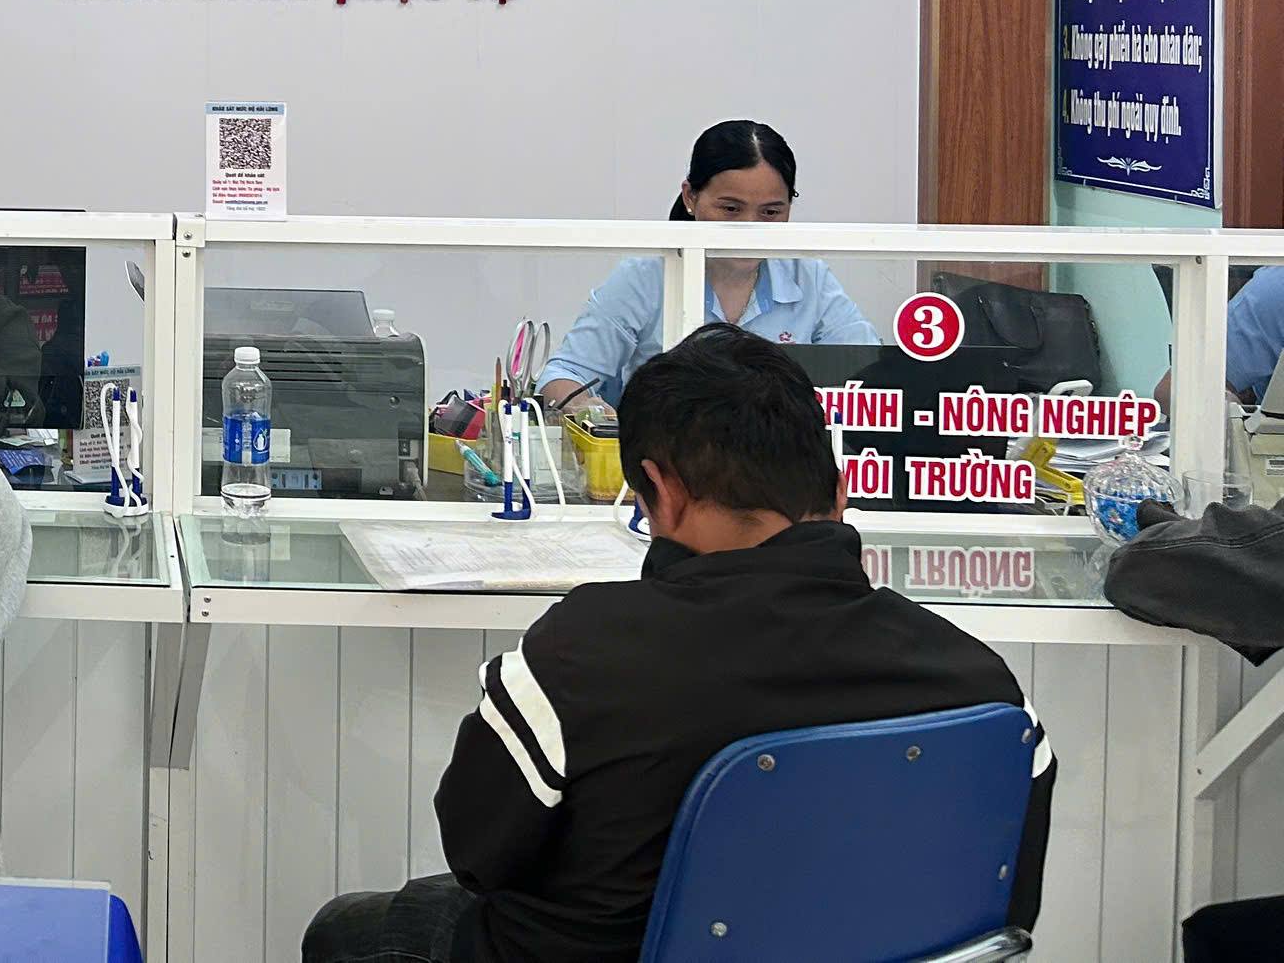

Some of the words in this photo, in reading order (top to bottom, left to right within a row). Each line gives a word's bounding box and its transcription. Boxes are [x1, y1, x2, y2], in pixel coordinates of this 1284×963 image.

[1071, 24, 1093, 69] Không
[1094, 25, 1108, 70] gây
[1131, 25, 1141, 63] hà
[1143, 25, 1158, 64] cho
[1159, 25, 1181, 65] nhân
[1182, 25, 1203, 73] dân;
[1070, 89, 1092, 134] Không
[1093, 91, 1106, 128] thu
[1107, 91, 1120, 137] phí
[1120, 94, 1143, 138] ngoài
[911, 304, 946, 350] 3
[943, 390, 1029, 435] NÔNG
[911, 451, 1033, 499] TRƯỜNG
